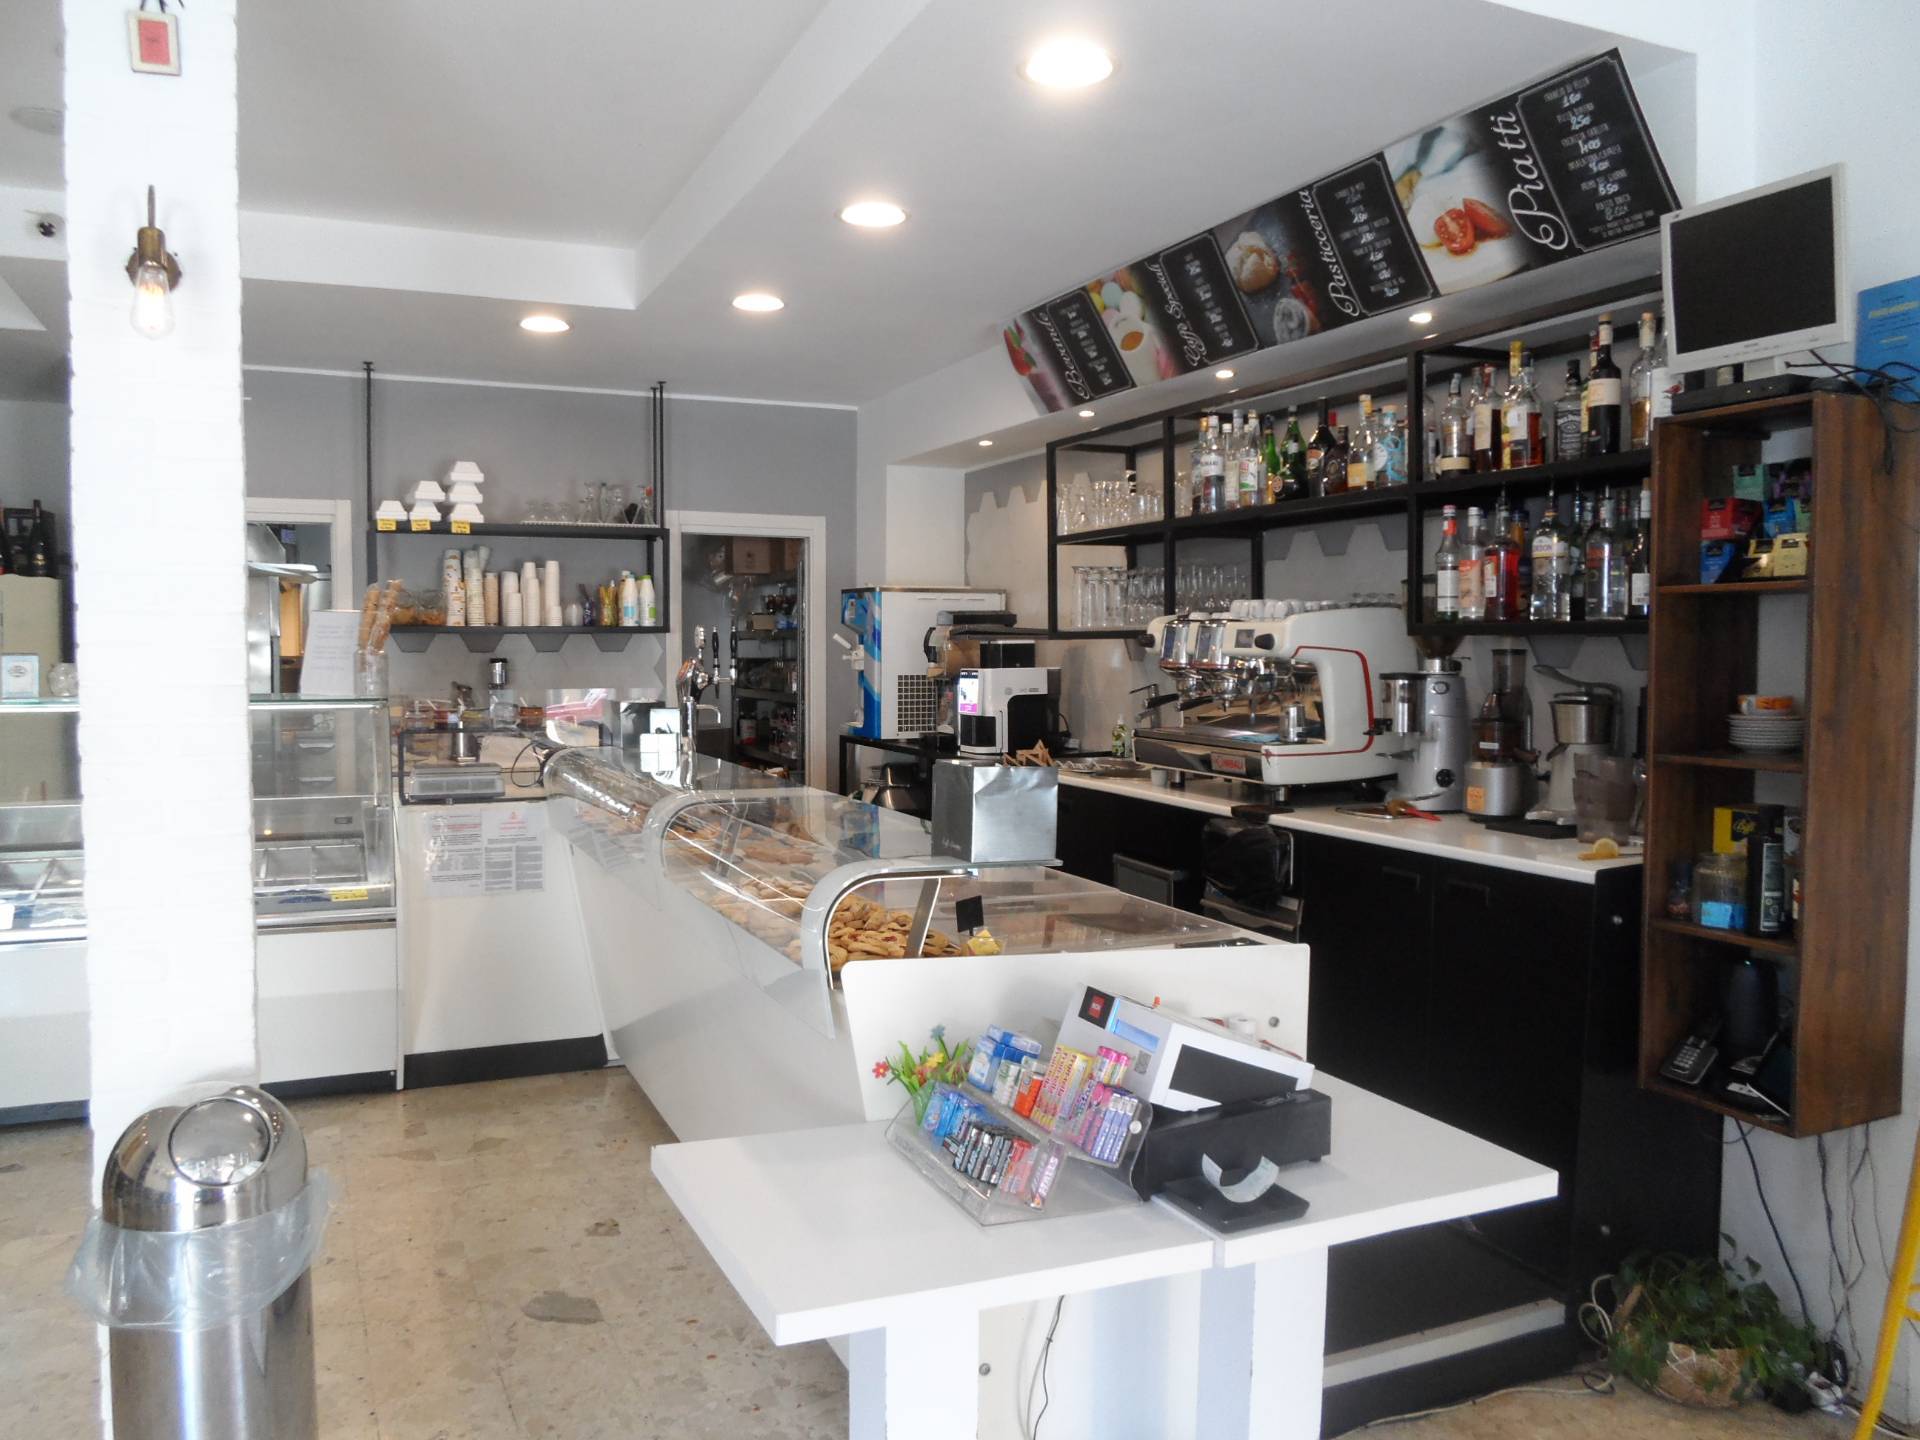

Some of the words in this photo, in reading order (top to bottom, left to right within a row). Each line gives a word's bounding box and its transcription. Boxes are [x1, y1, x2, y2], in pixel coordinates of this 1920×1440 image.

[1490, 111, 1569, 250] Piatti
[1298, 189, 1360, 317] Pasticceria
[1031, 312, 1090, 400] Bevande
[1037, 1156, 1059, 1198] HALLS
